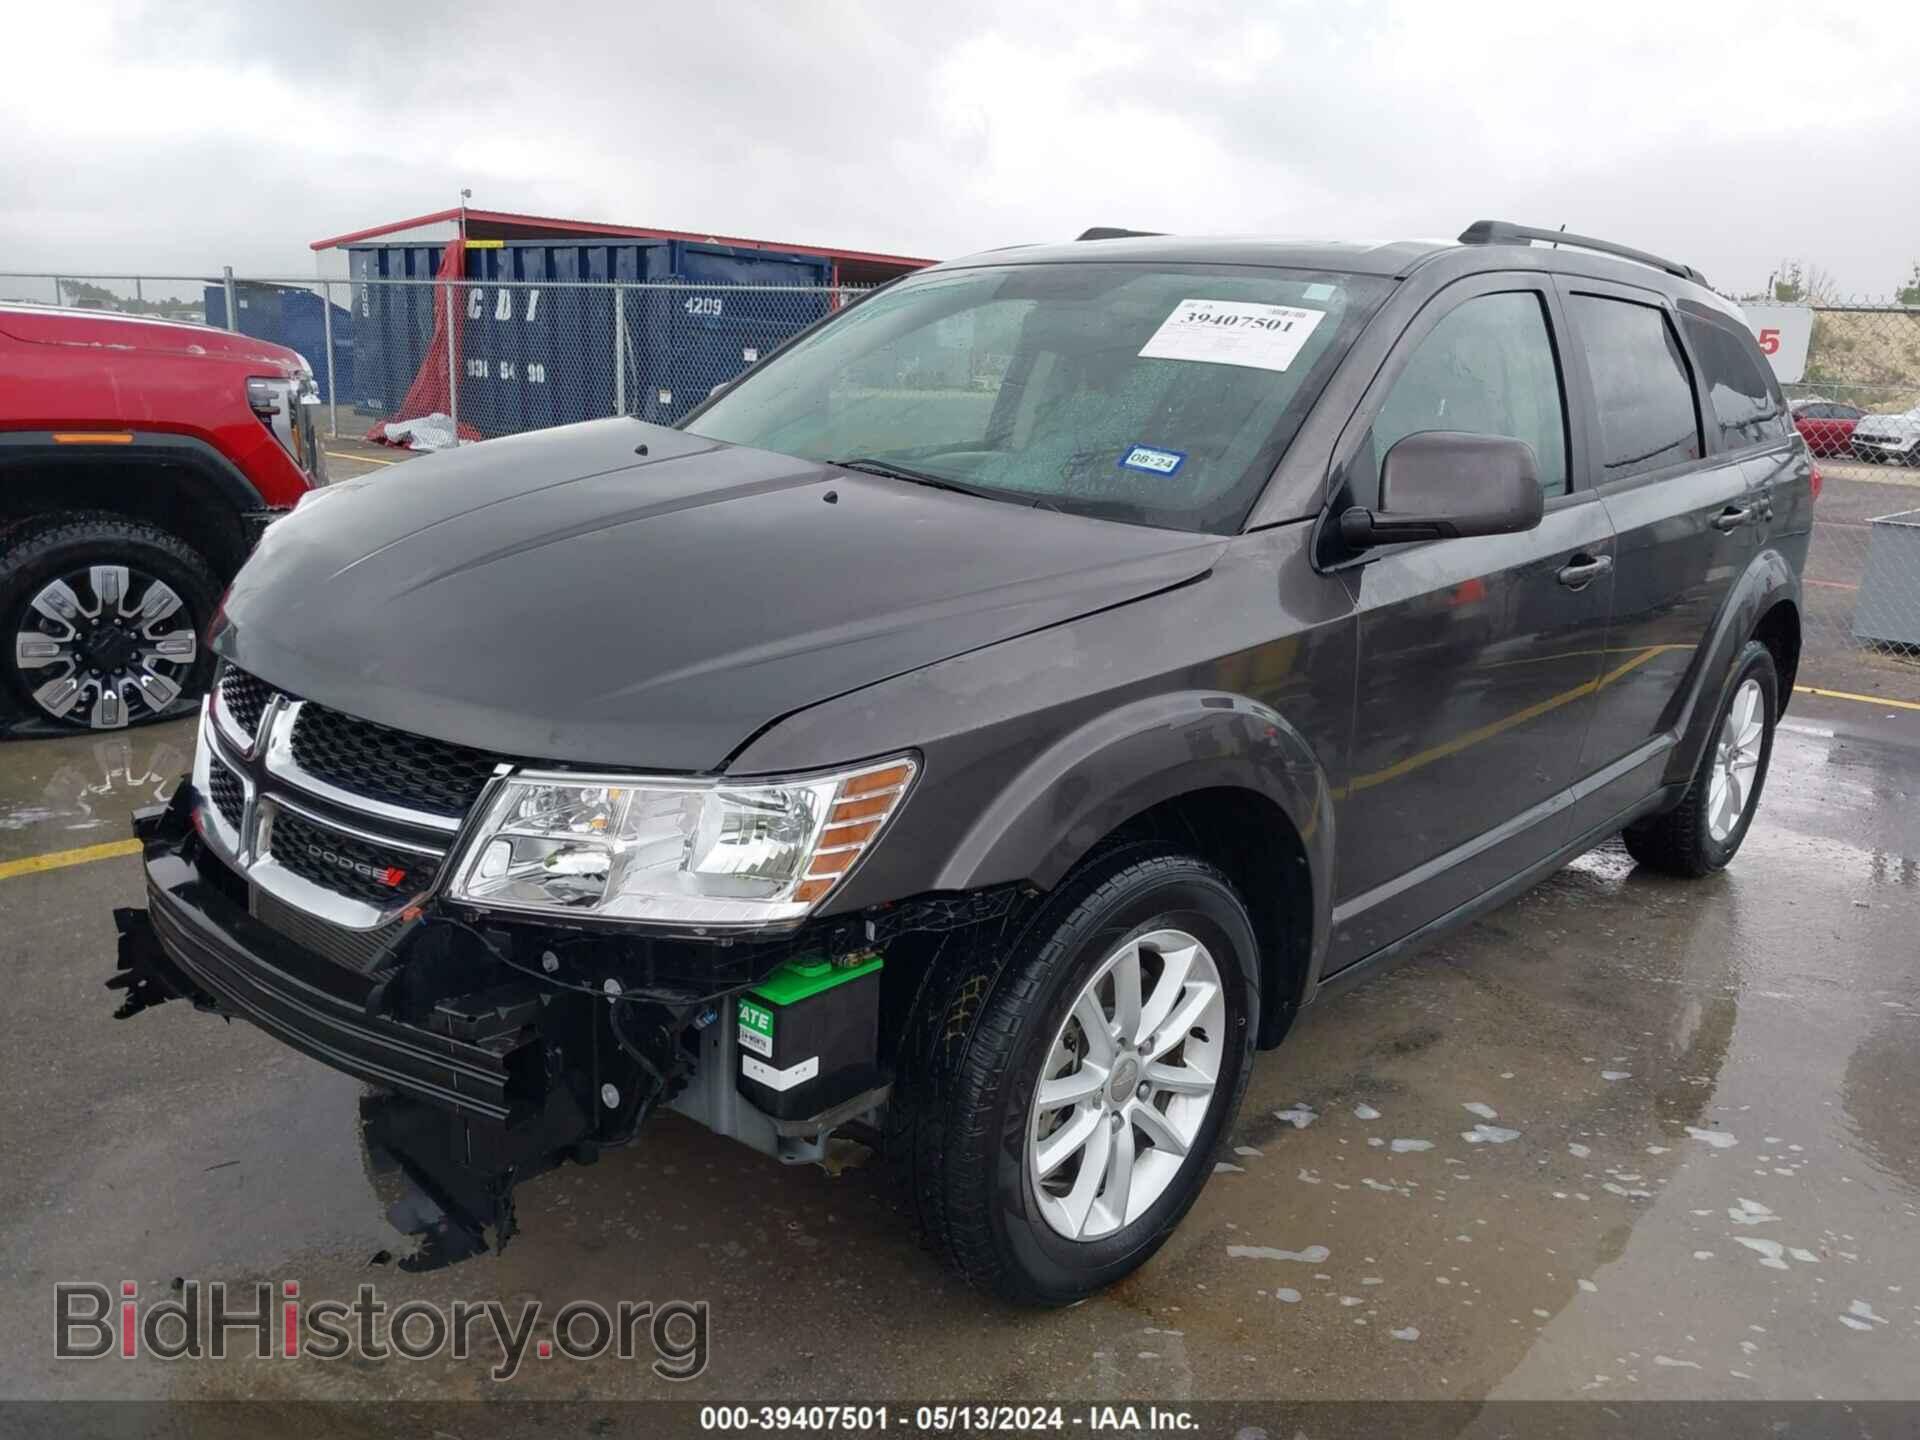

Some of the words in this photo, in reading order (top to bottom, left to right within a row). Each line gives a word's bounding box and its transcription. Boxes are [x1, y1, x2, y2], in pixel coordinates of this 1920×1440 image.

[685, 297, 722, 315] 4209
[1180, 311, 1294, 332] 39407501
[1759, 328, 1780, 355] 5
[307, 844, 390, 884] DODGE
[740, 1004, 769, 1030] ATE
